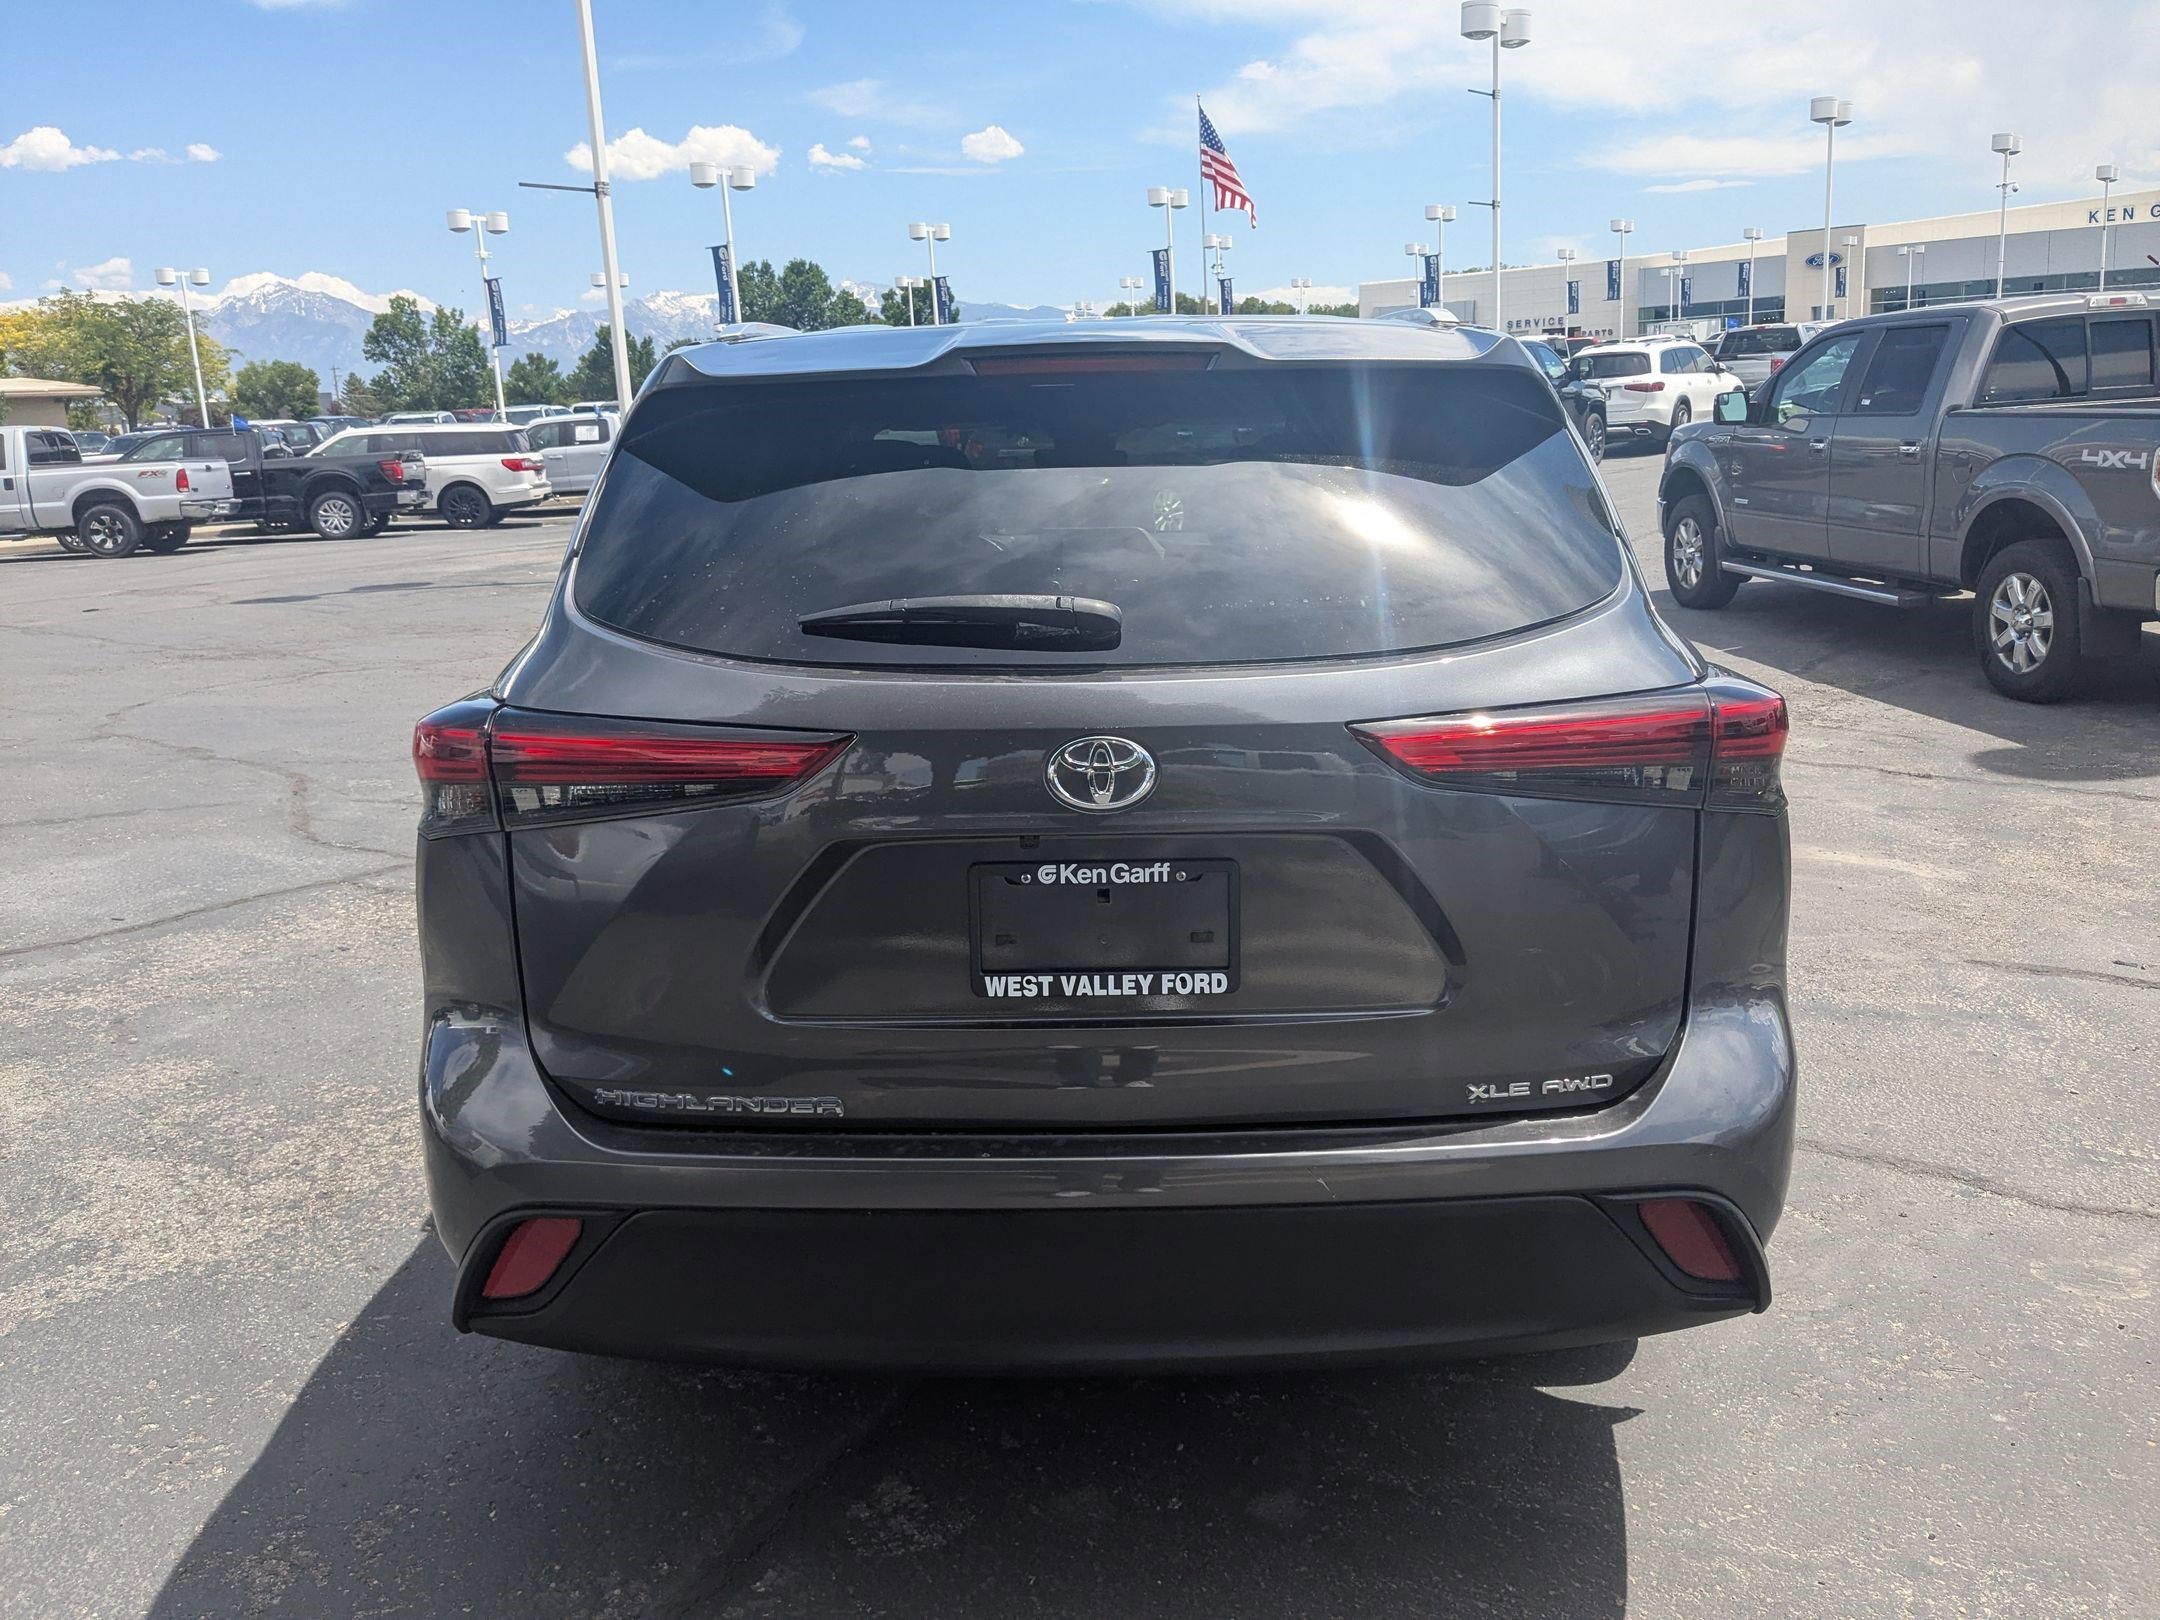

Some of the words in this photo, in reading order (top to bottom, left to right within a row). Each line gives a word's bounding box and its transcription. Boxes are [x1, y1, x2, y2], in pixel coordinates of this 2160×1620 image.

[2088, 207, 2135, 224] KEN
[1506, 316, 1564, 329] SERVICE
[1582, 328, 1614, 337] PARTS
[1060, 863, 1106, 884] Ken
[1110, 861, 1171, 884] Garff
[984, 975, 1054, 997] WEST
[1061, 974, 1155, 996] VALLEY
[1162, 973, 1228, 994] FORD
[1466, 1082, 1531, 1101] XLE
[1541, 1074, 1613, 1095] AWD
[594, 1088, 845, 1117] HIGHLANDER
